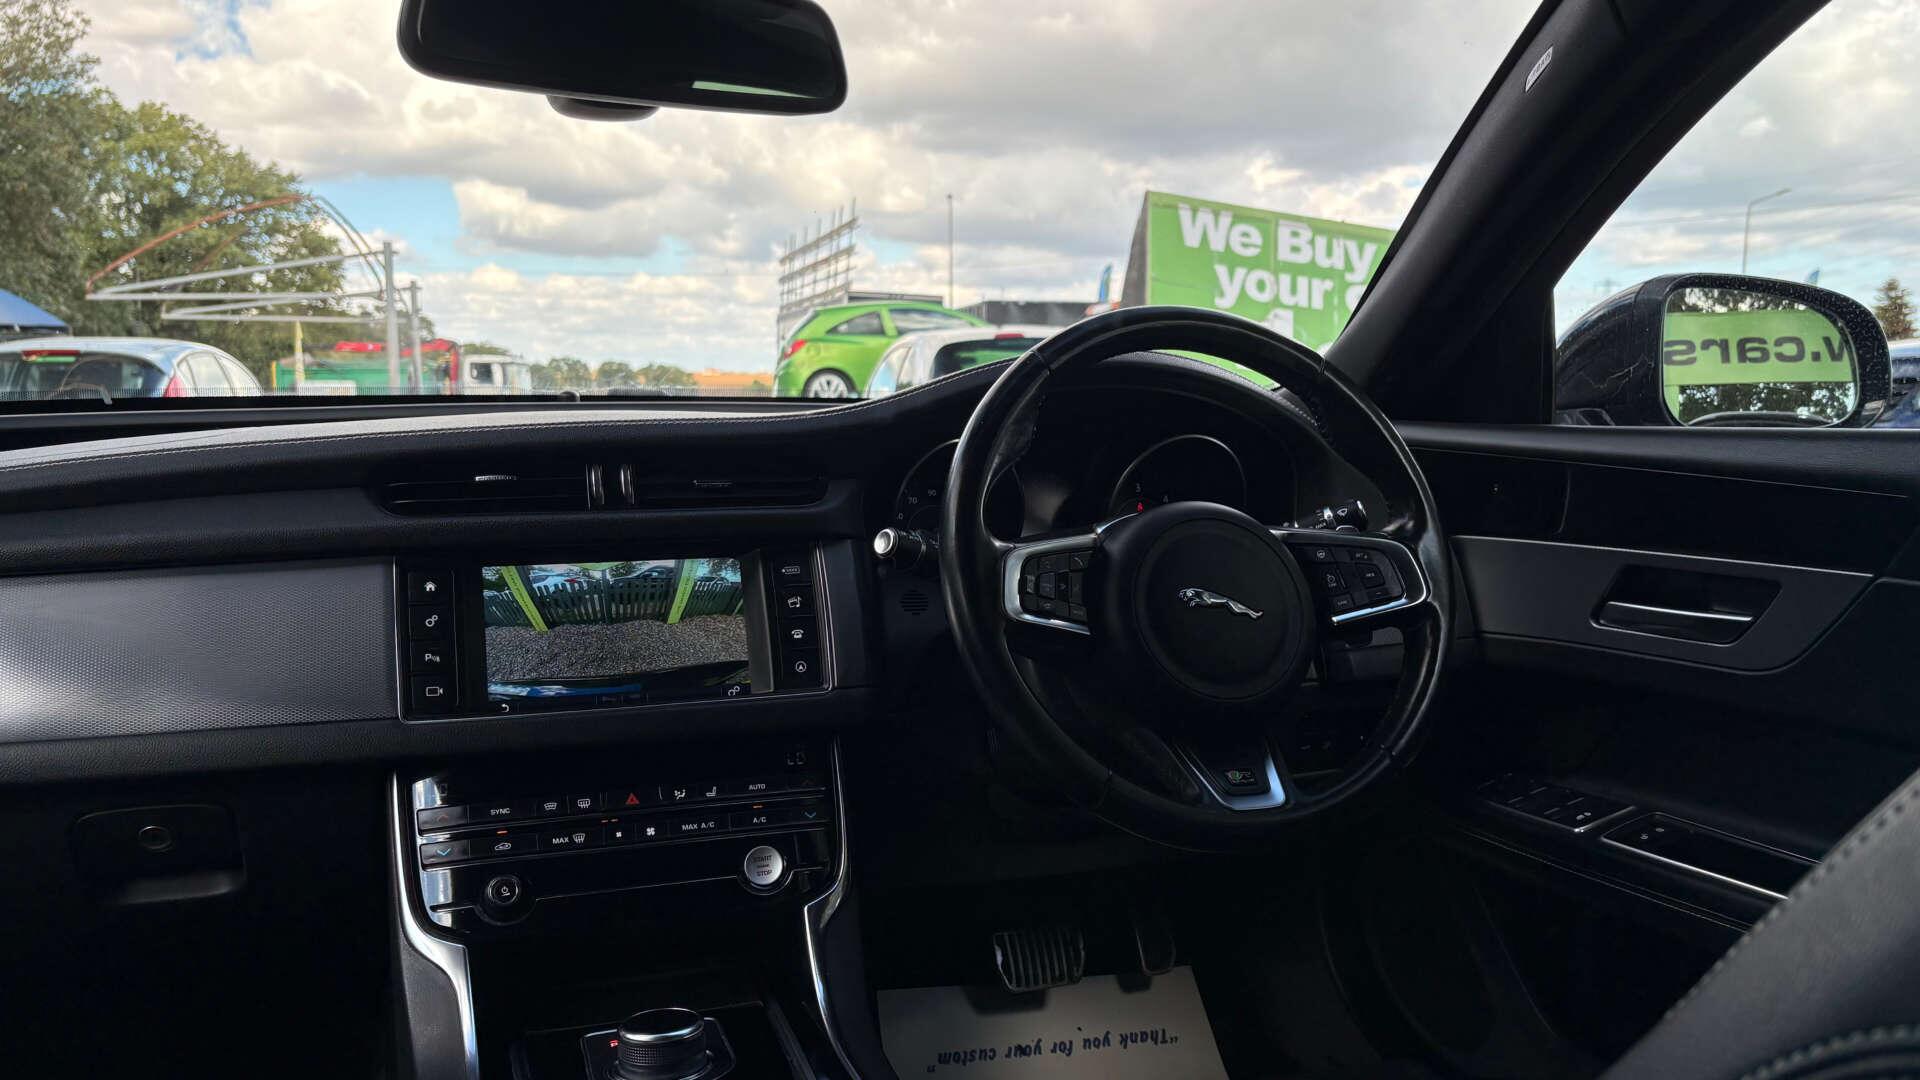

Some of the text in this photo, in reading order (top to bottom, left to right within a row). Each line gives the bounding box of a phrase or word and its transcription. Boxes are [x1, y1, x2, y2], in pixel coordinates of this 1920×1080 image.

[1178, 203, 1377, 282] We Buy
[1213, 264, 1334, 310] your
[748, 783, 766, 791] AUTO
[490, 807, 511, 816] SYNC
[681, 821, 716, 832] MAX A/C
[752, 816, 767, 824] A/C
[552, 836, 570, 845] MAX
[1082, 1030, 1111, 1050] you
[1004, 1037, 1042, 1059] your
[1050, 1039, 1073, 1057] for
